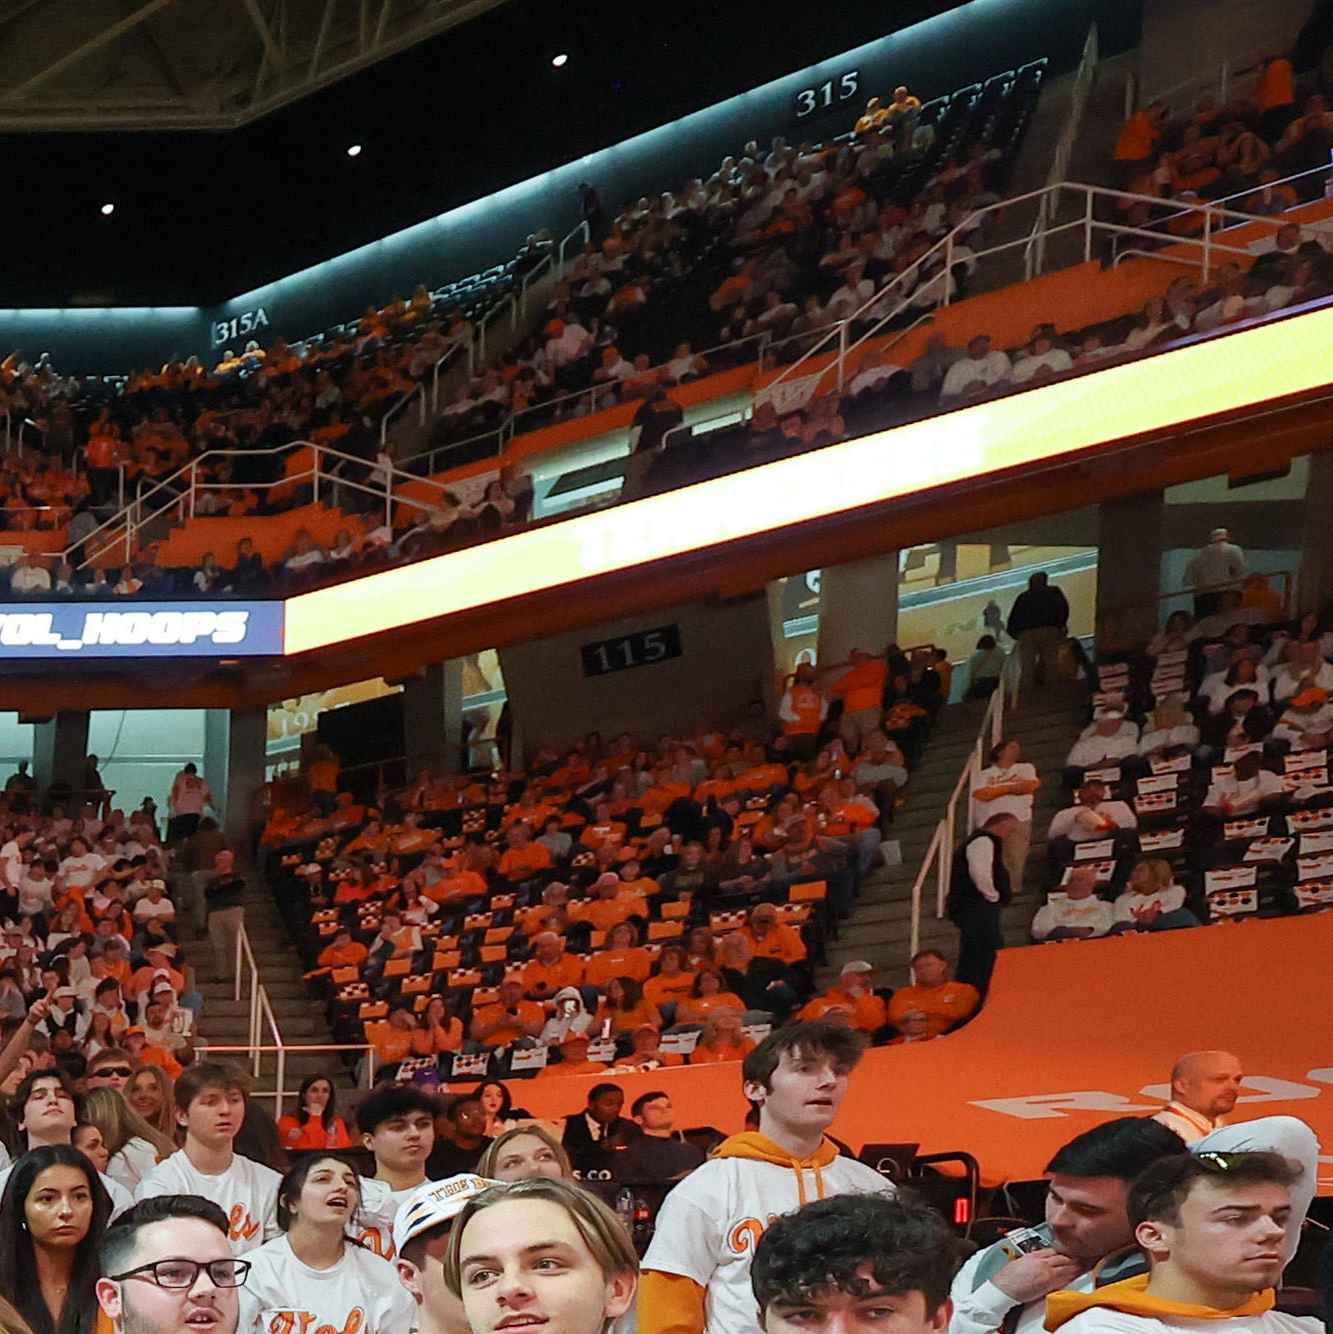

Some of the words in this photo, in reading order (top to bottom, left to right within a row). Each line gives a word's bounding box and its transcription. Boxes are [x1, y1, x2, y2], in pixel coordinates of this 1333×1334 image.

[796, 71, 860, 118] 315
[214, 307, 269, 346] 315A
[591, 632, 668, 672] 115
[428, 1178, 470, 1202] THE
